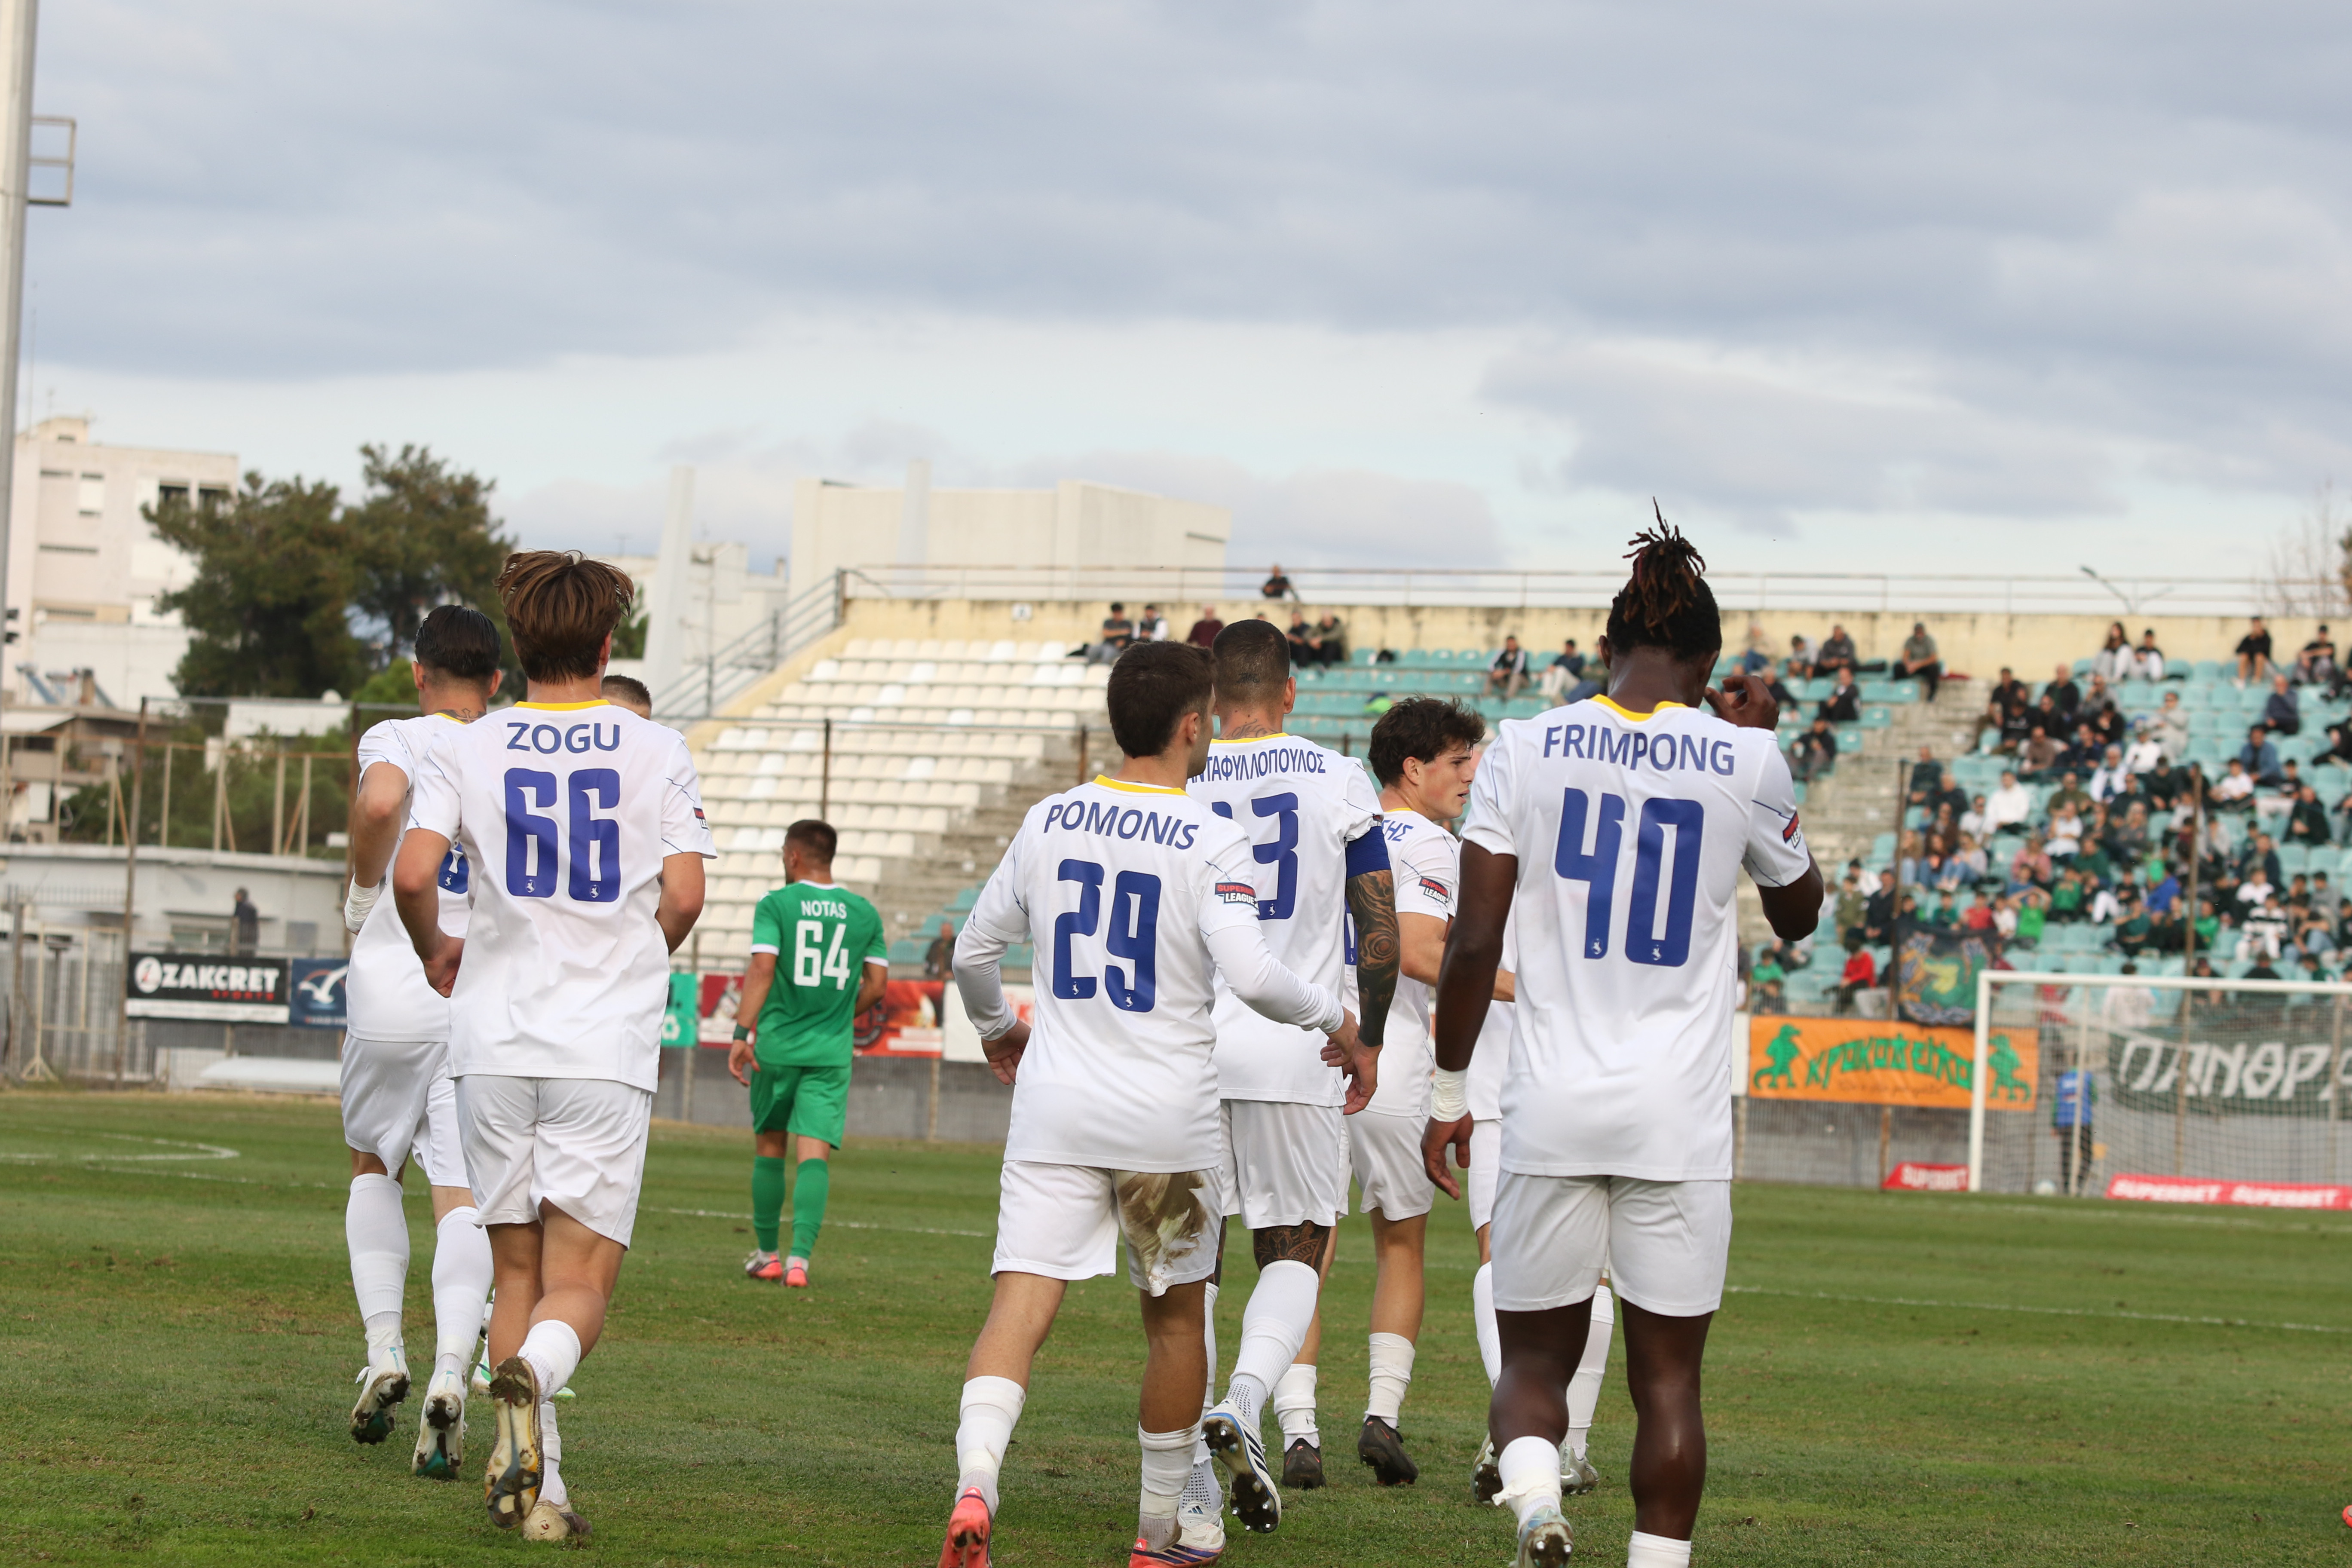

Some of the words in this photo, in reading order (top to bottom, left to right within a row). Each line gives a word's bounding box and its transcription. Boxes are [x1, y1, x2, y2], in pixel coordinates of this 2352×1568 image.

[507, 723, 620, 754] ZOGU
[1544, 724, 1735, 775] FRIMPONG
[1186, 748, 1326, 783] ΤΑΦΥΛΛΟΠΟΥΛΟΣ
[504, 768, 621, 902] 66
[1044, 800, 1199, 850] POMONIS
[1212, 792, 1298, 920] 3
[1555, 787, 1704, 967] 40
[801, 900, 847, 919] NOTAS
[1421, 879, 1448, 896] SUPERB
[794, 920, 850, 990] 64
[1053, 859, 1161, 1012] 29
[161, 963, 280, 993] ZAKCRET
